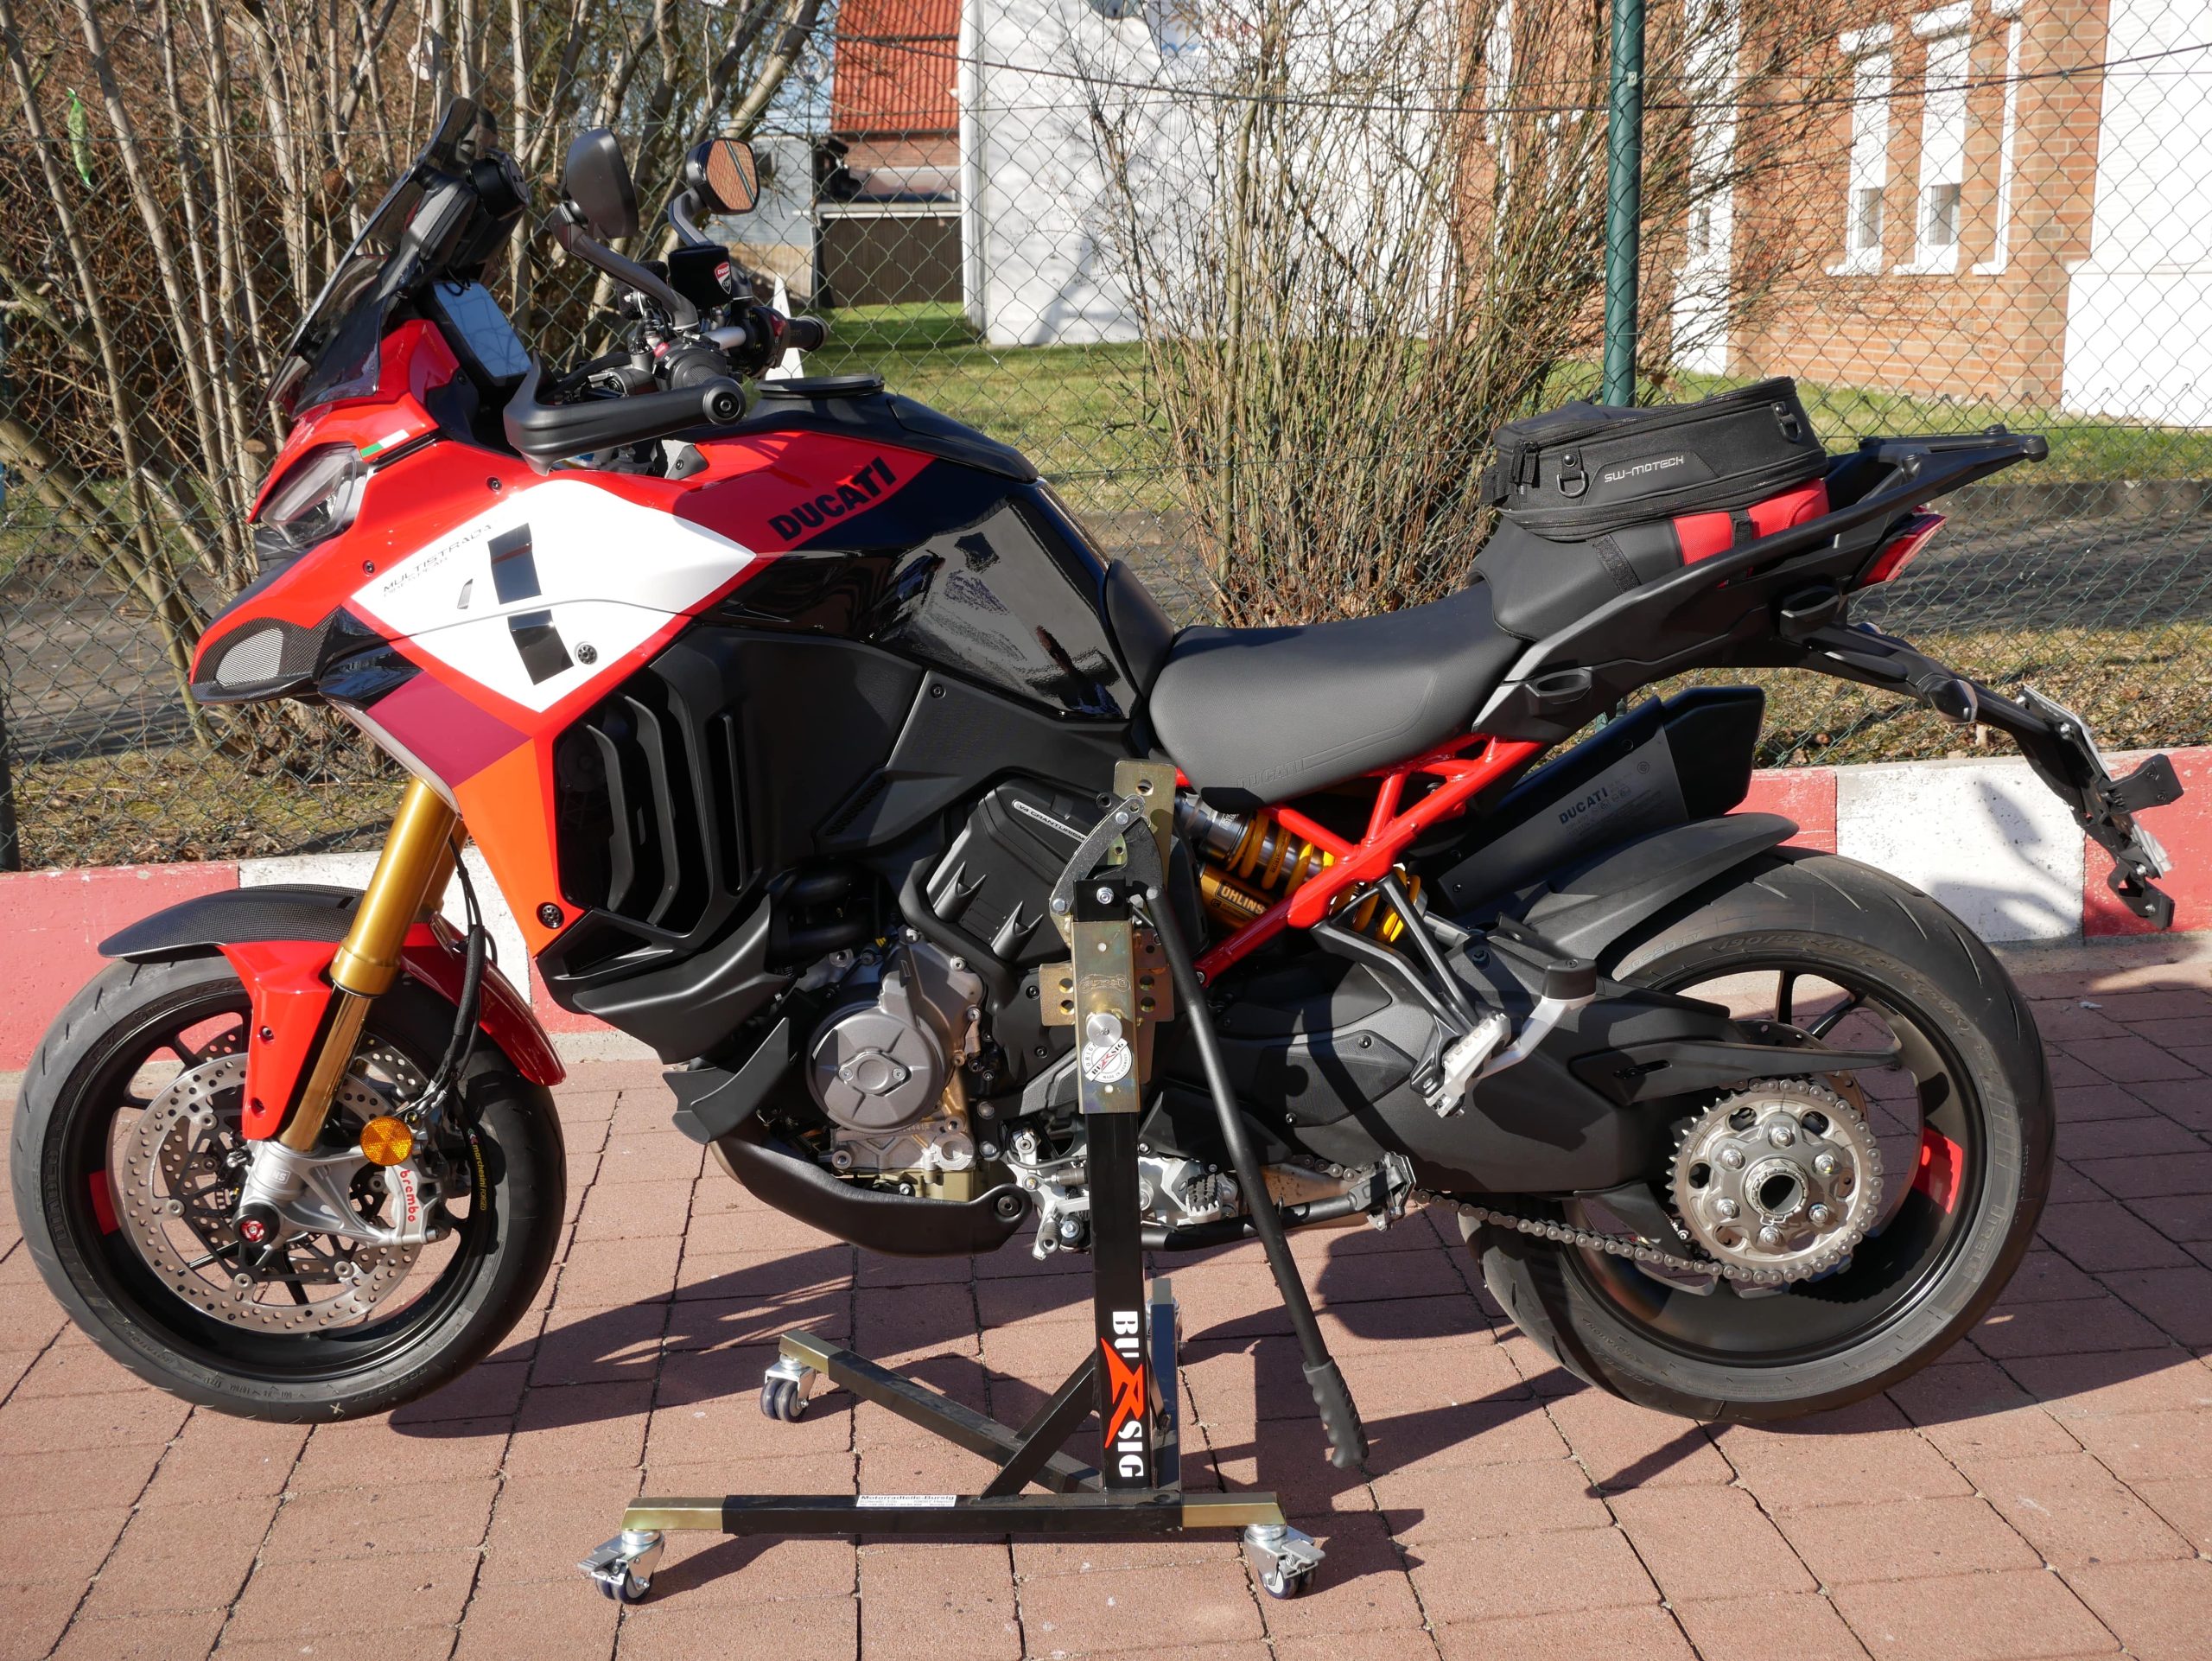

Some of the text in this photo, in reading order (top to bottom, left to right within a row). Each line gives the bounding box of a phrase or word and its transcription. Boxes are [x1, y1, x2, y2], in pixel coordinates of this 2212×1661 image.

[1604, 455, 1685, 483] SW-MOTECH
[767, 456, 898, 542] DUCATI
[1558, 787, 1609, 824] DUCATI
[1030, 811, 1085, 842] GRANTURISM
[400, 1169, 420, 1222] brembo
